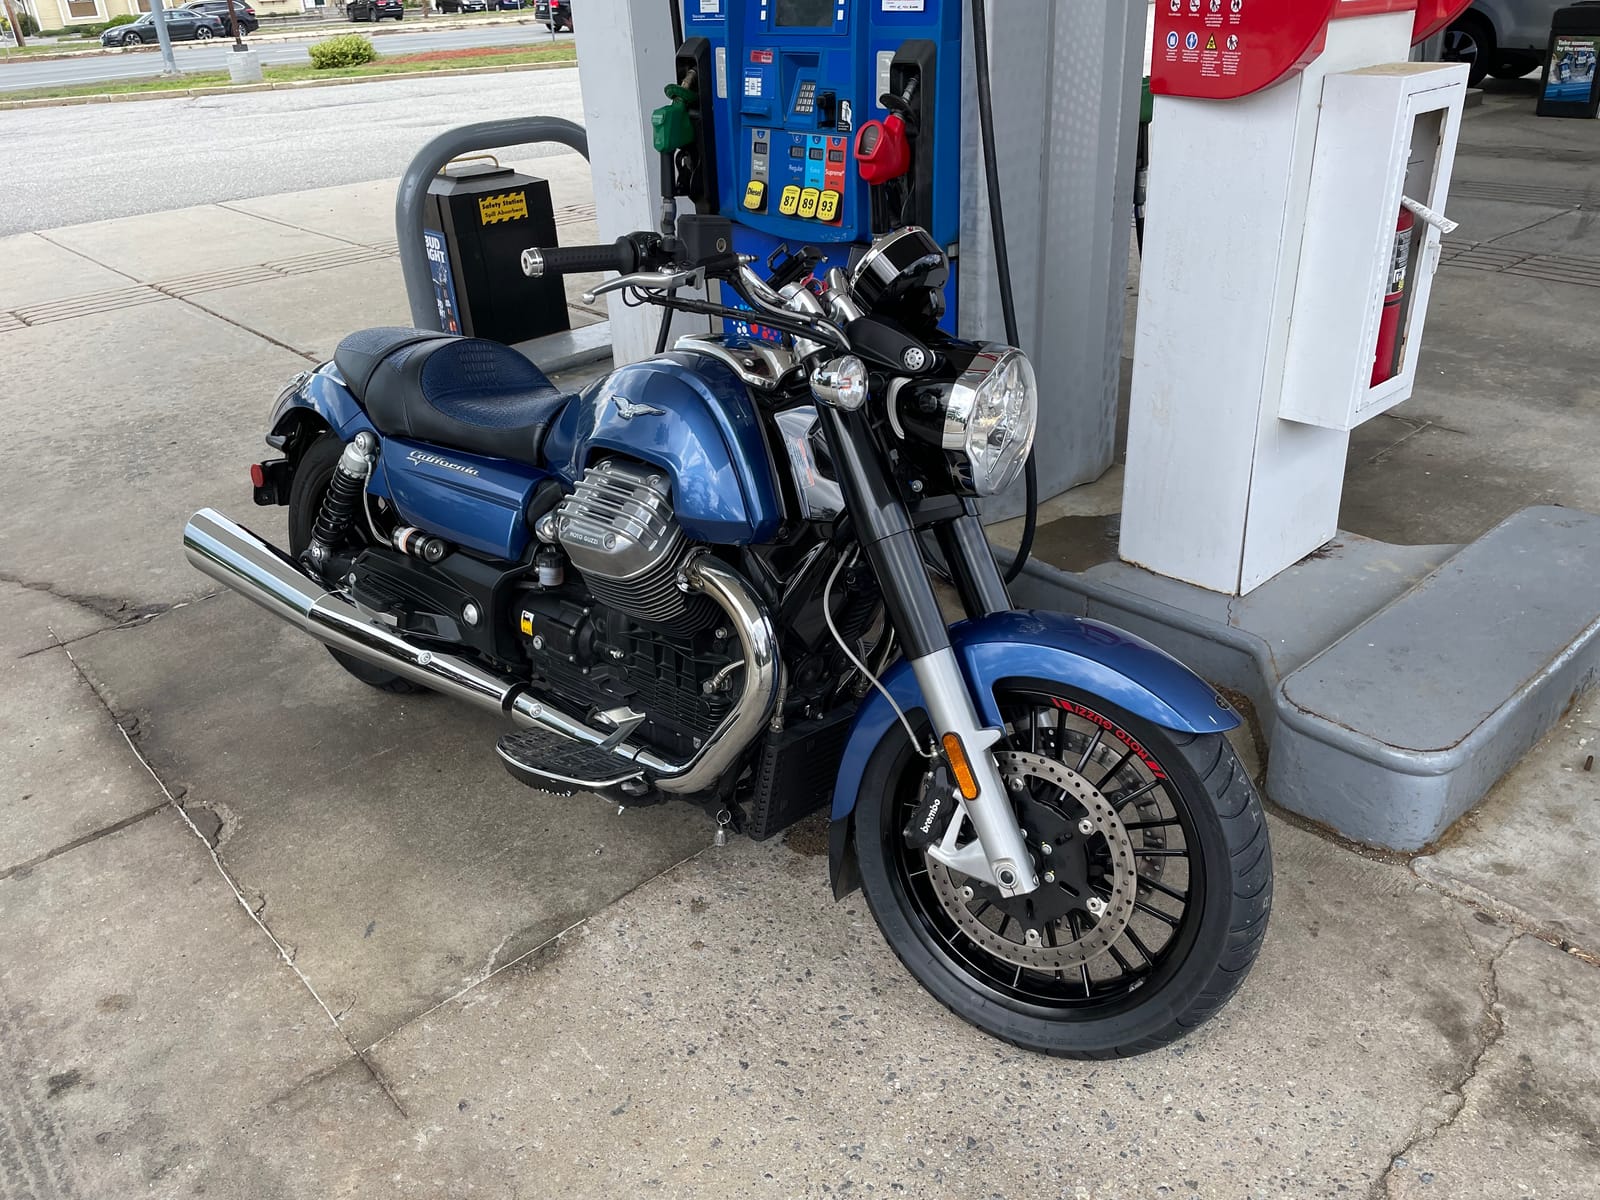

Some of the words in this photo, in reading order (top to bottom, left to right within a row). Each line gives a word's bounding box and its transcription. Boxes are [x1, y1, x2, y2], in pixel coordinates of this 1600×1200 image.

[788, 164, 803, 173] Regular
[747, 187, 761, 196] Diesel
[482, 202, 501, 210] Safety
[783, 195, 795, 207] 87
[802, 198, 814, 209] 89
[821, 200, 833, 212] 93
[408, 450, 480, 477] California
[1074, 706, 1113, 731] GUZZI
[1115, 729, 1149, 760] MOTO
[919, 798, 941, 834] brembo
